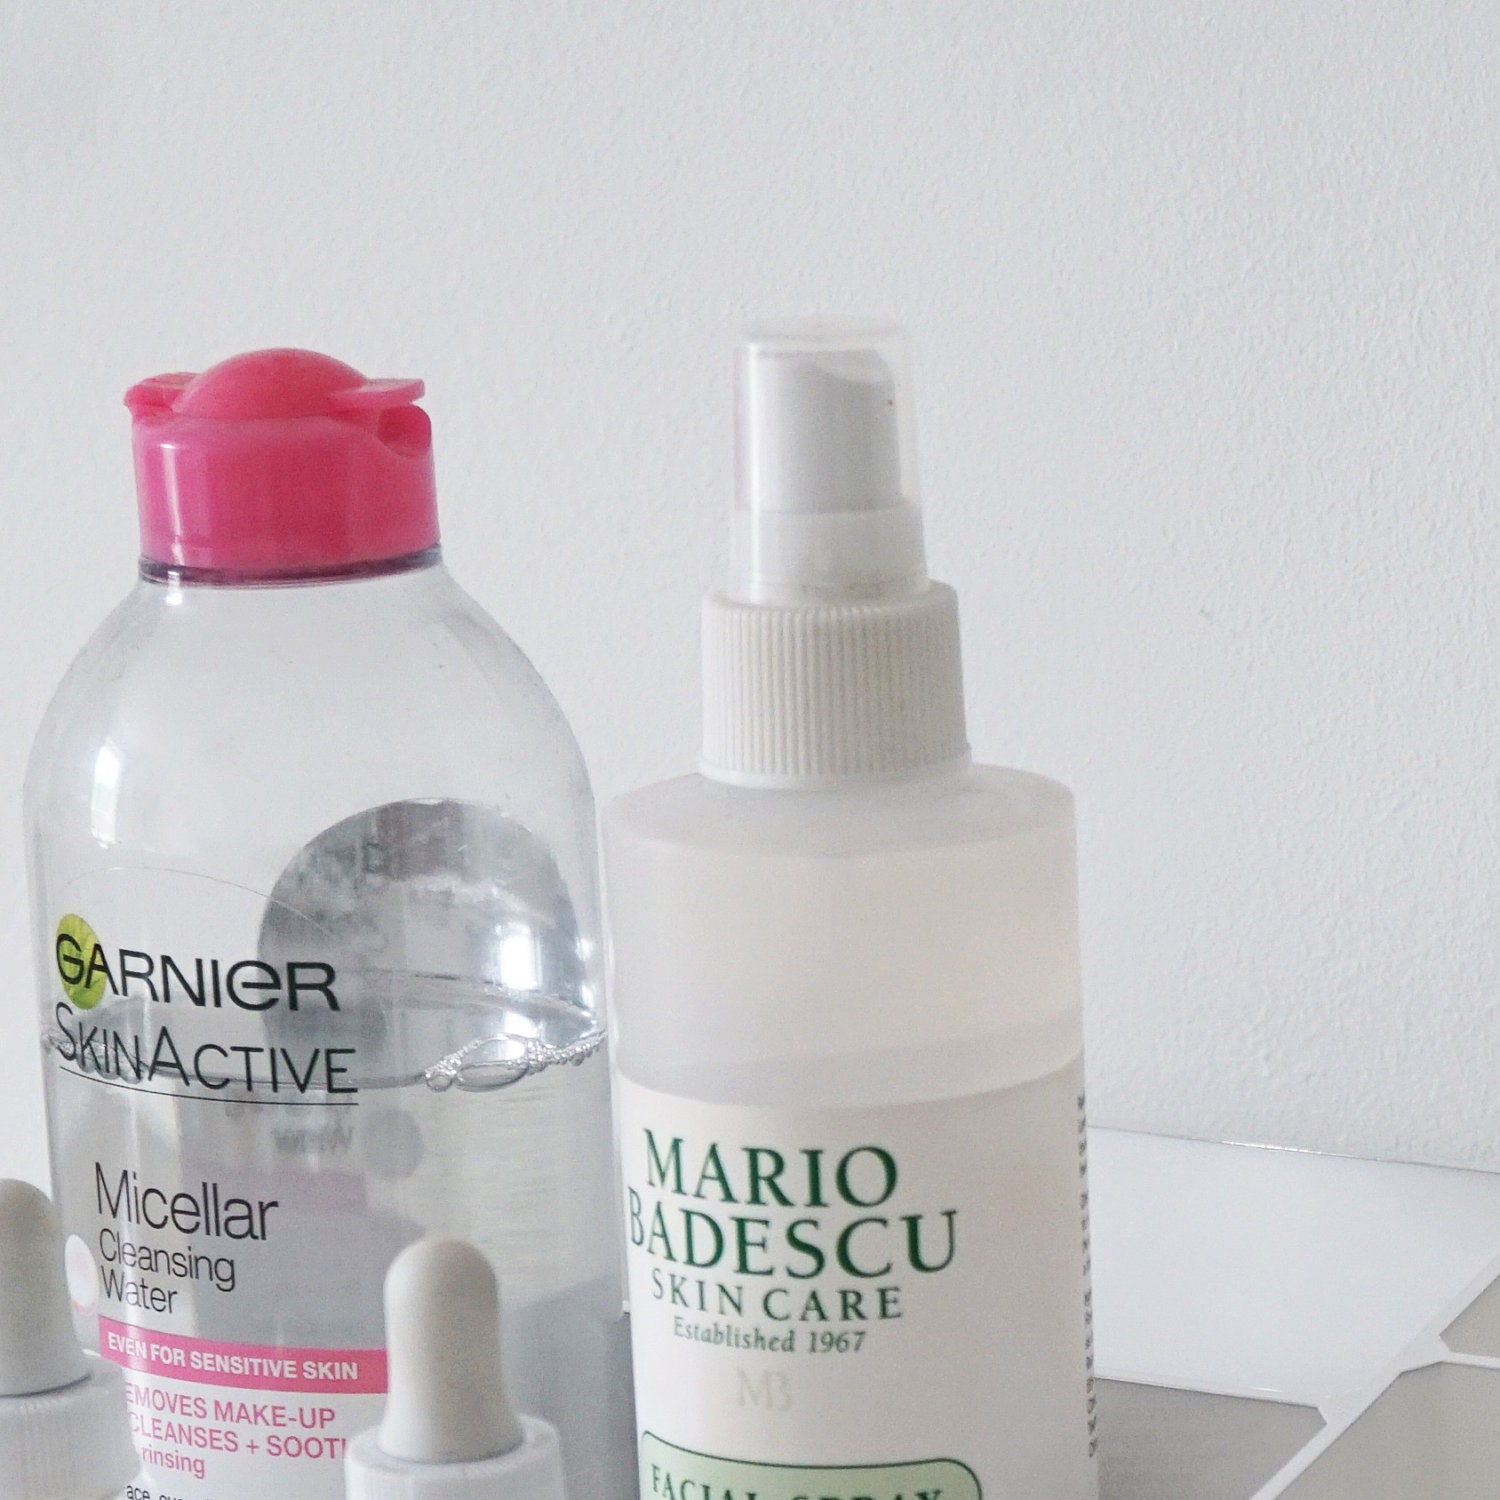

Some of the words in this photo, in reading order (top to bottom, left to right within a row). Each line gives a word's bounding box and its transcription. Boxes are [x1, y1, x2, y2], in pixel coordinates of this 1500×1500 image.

[644, 1128, 898, 1208] MARIO
[95, 1162, 279, 1241] Micellar
[627, 1186, 958, 1280] BADESCU
[99, 1228, 237, 1293] Cleansing
[100, 1265, 178, 1314] Water
[651, 1267, 746, 1319] SKIN
[762, 1286, 904, 1322] CARE
[107, 1331, 148, 1360] EVEN
[151, 1344, 186, 1368] FOR
[190, 1350, 298, 1379] SENSITIVE
[302, 1360, 359, 1381] SKIN
[673, 1316, 796, 1354] Established
[808, 1330, 867, 1354] 1967
[125, 1382, 208, 1419] EMOVES
[213, 1400, 336, 1430] MAKE-UP
[141, 1445, 206, 1480] rinsing
[266, 1434, 347, 1460] SOOT
